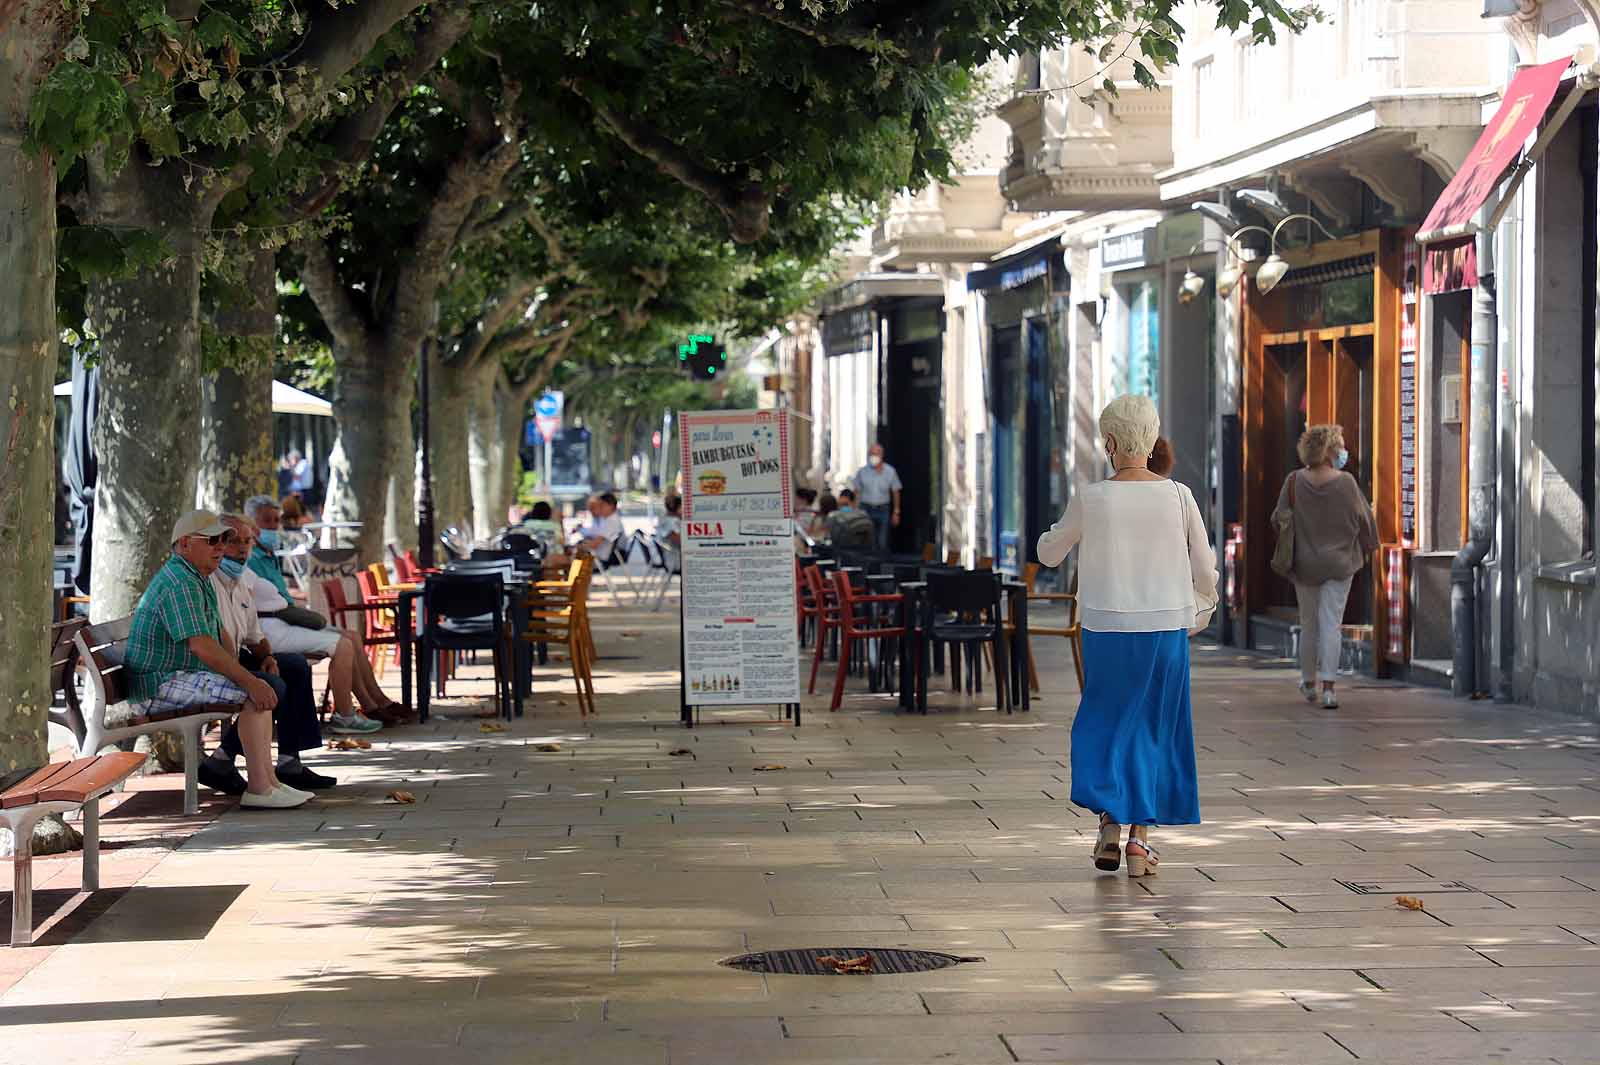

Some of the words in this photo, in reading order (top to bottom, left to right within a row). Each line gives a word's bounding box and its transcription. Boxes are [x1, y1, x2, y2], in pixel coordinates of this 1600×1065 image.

[692, 443, 756, 465] HAMBURGUESAS
[741, 461, 757, 477] HOT
[759, 458, 779, 474] DOGS
[687, 522, 724, 536] ISLA
